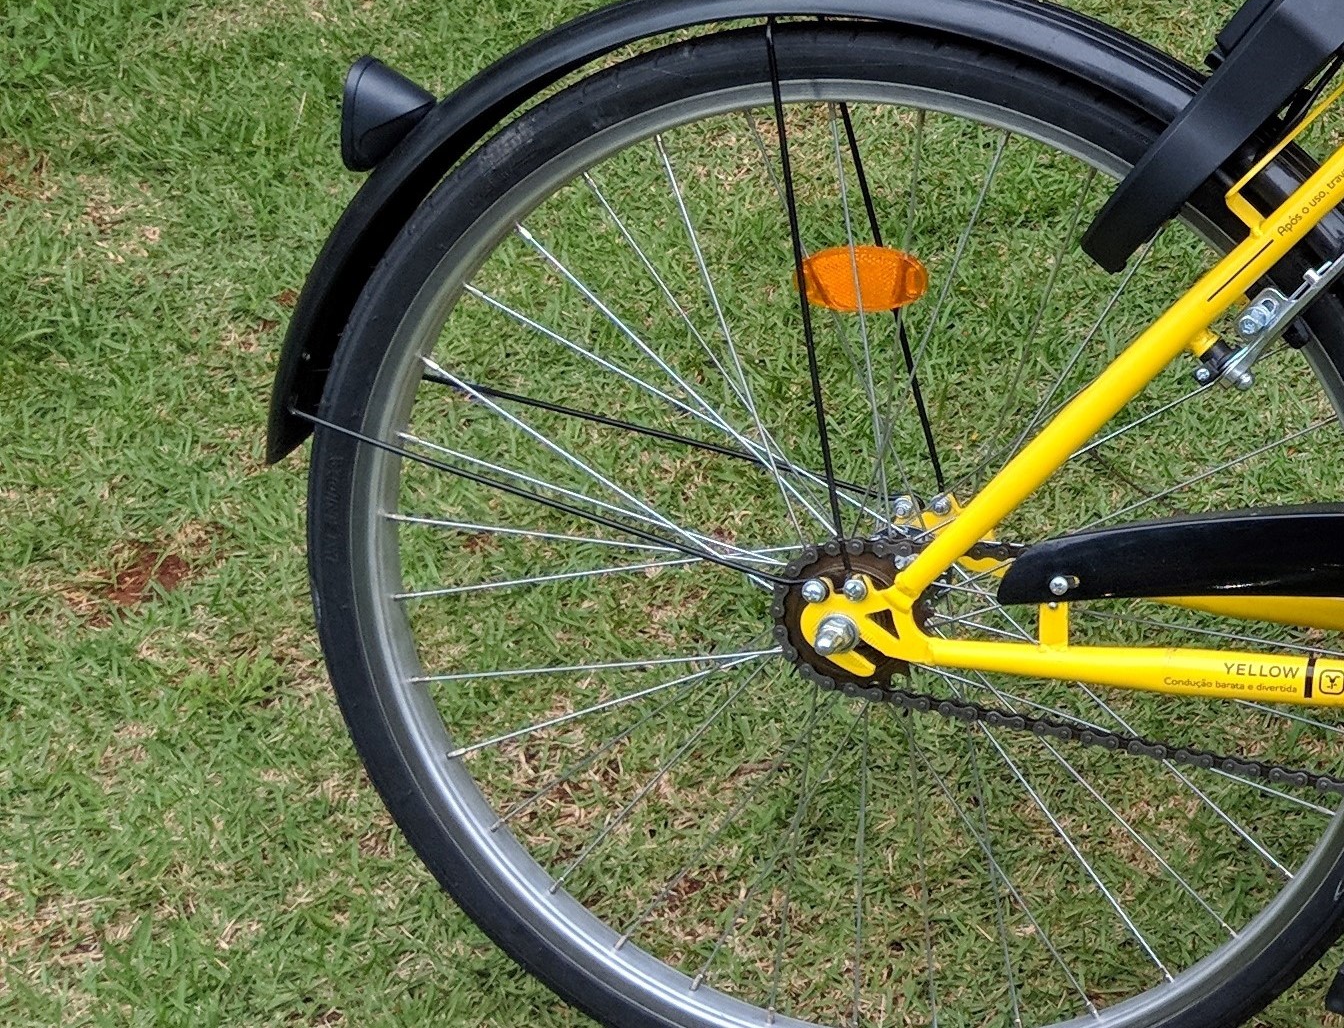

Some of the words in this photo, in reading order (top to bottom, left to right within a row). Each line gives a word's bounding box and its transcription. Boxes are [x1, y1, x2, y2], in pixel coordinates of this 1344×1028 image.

[1277, 213, 1302, 236] Após
[1301, 206, 1310, 214] o
[1308, 190, 1330, 208] uso,
[1223, 662, 1300, 679] YELLOW
[1163, 676, 1213, 688] Condução
[1215, 680, 1245, 691] barata
[1256, 683, 1298, 693] divertida
